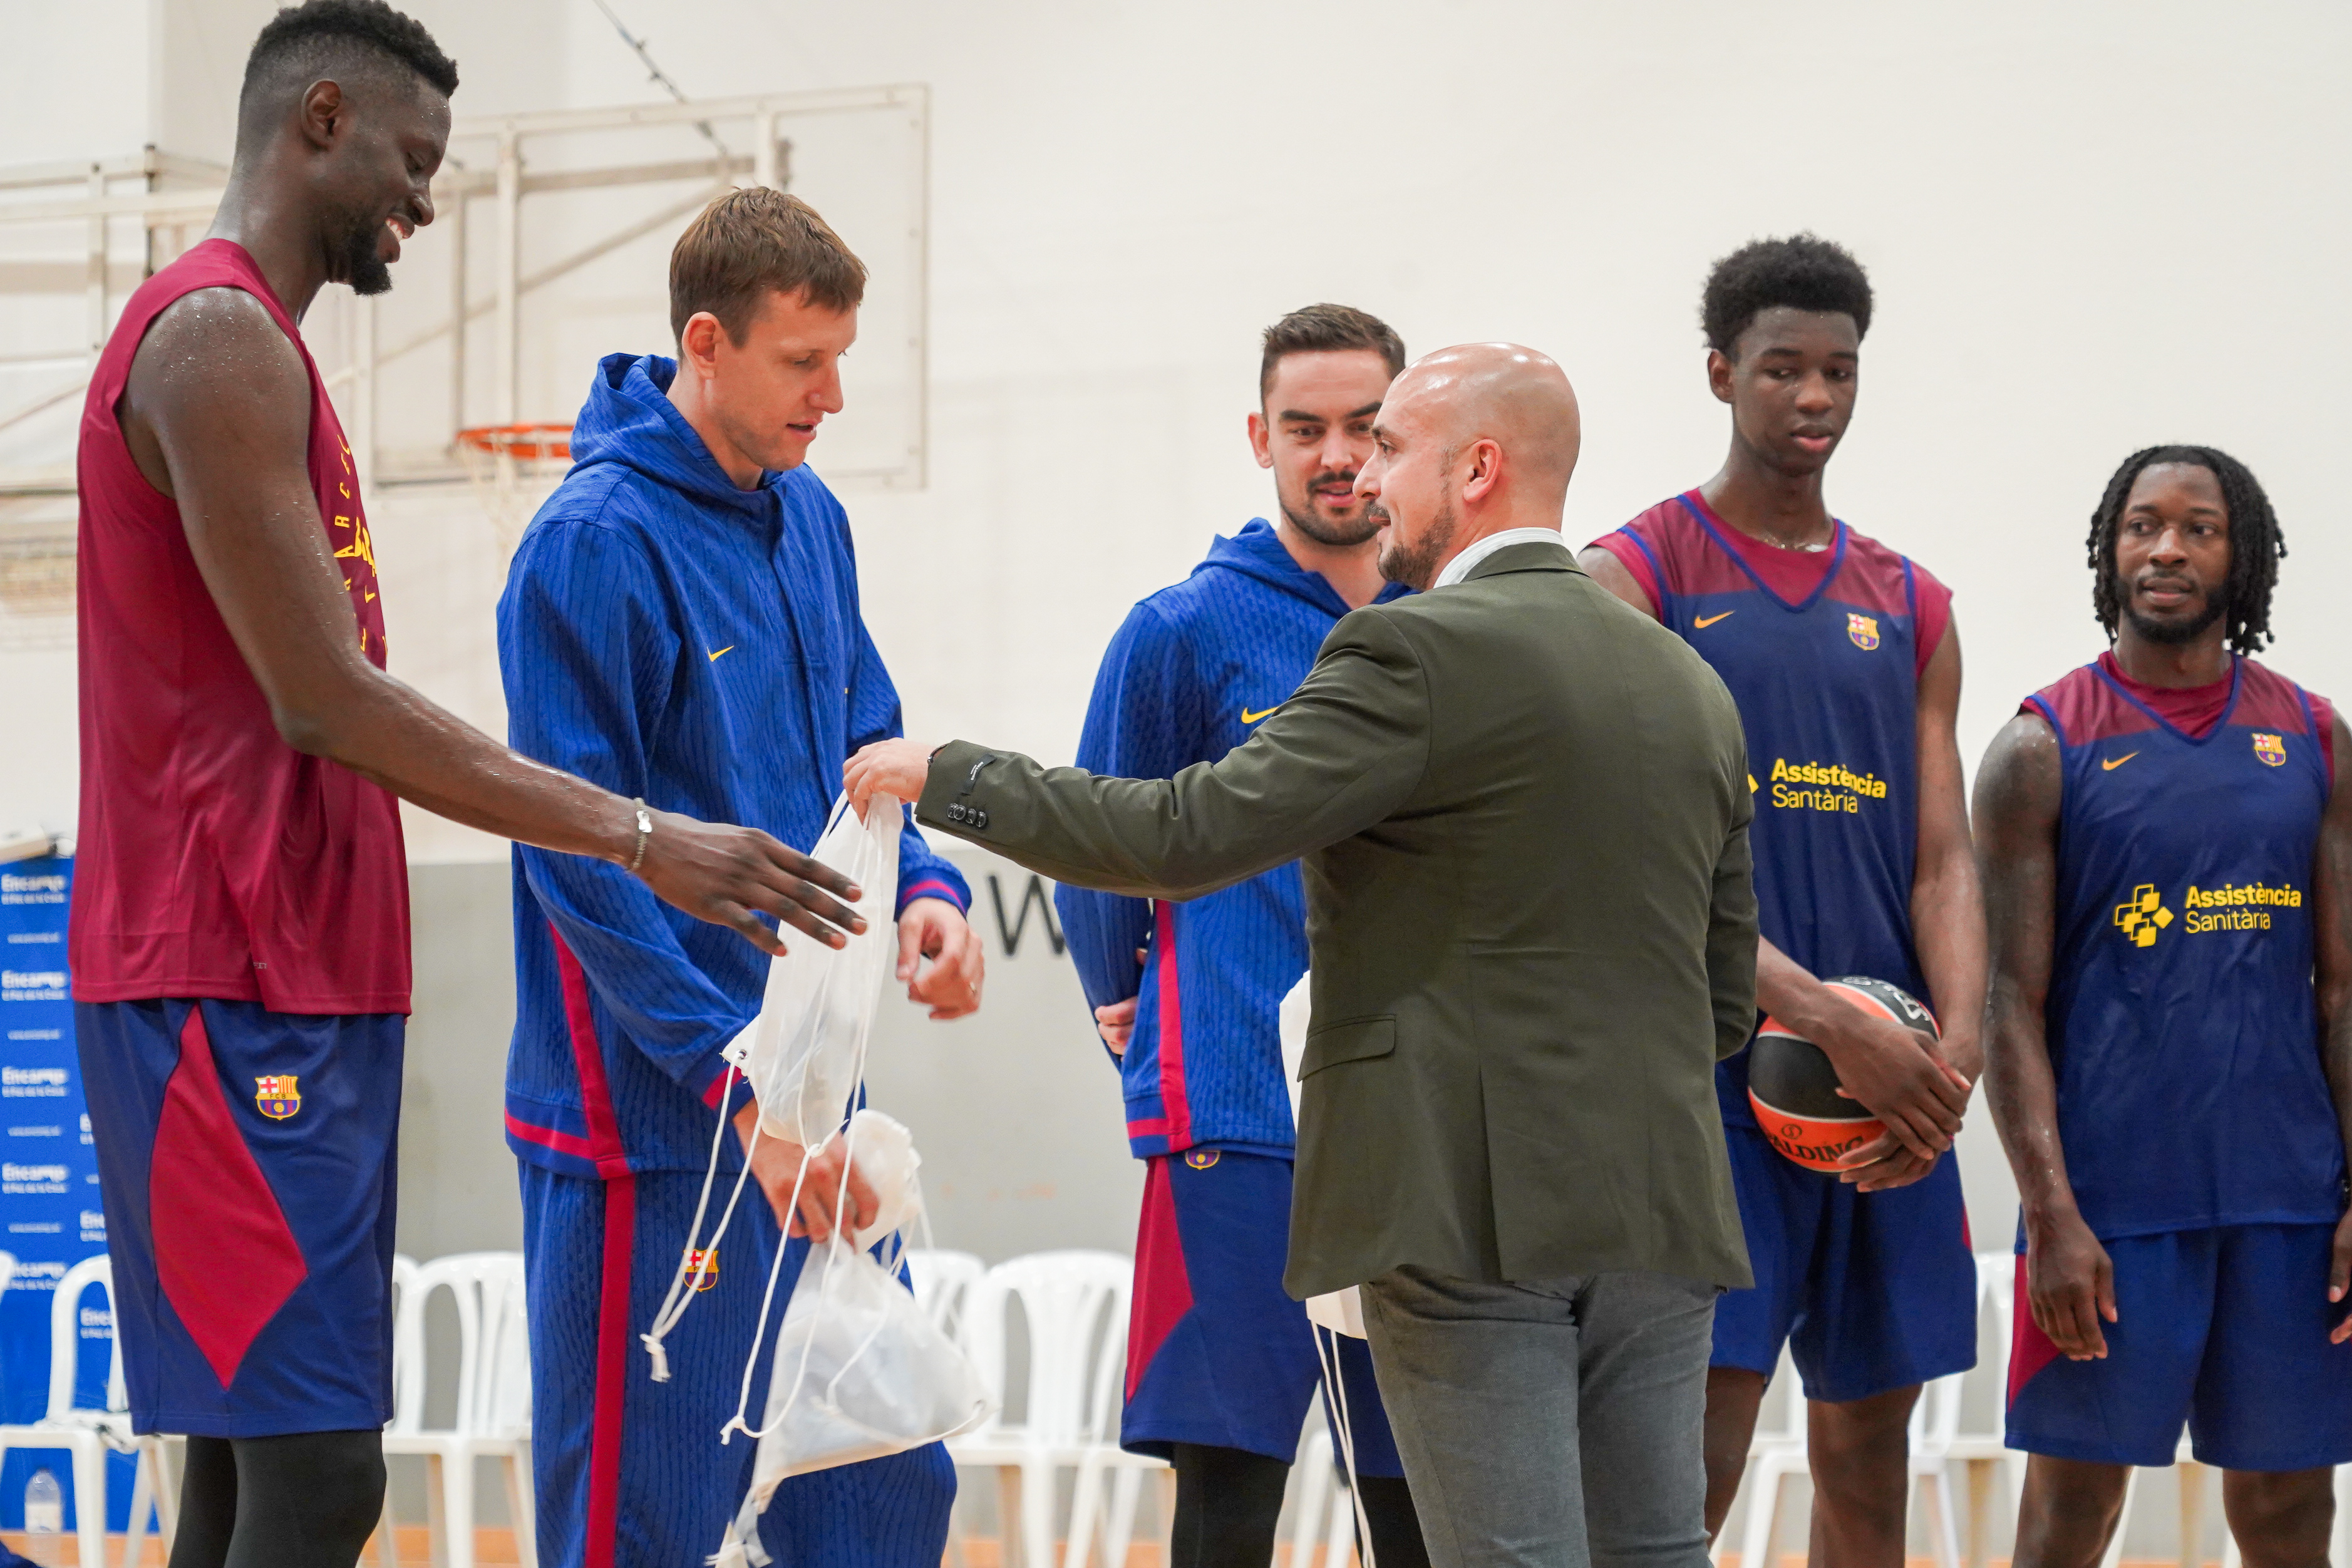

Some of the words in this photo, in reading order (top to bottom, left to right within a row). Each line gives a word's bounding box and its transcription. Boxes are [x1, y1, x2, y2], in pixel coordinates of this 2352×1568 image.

[1770, 758, 1887, 798] Assistència
[2185, 882, 2303, 909] Assistència
[2185, 907, 2271, 934] Sanitària
